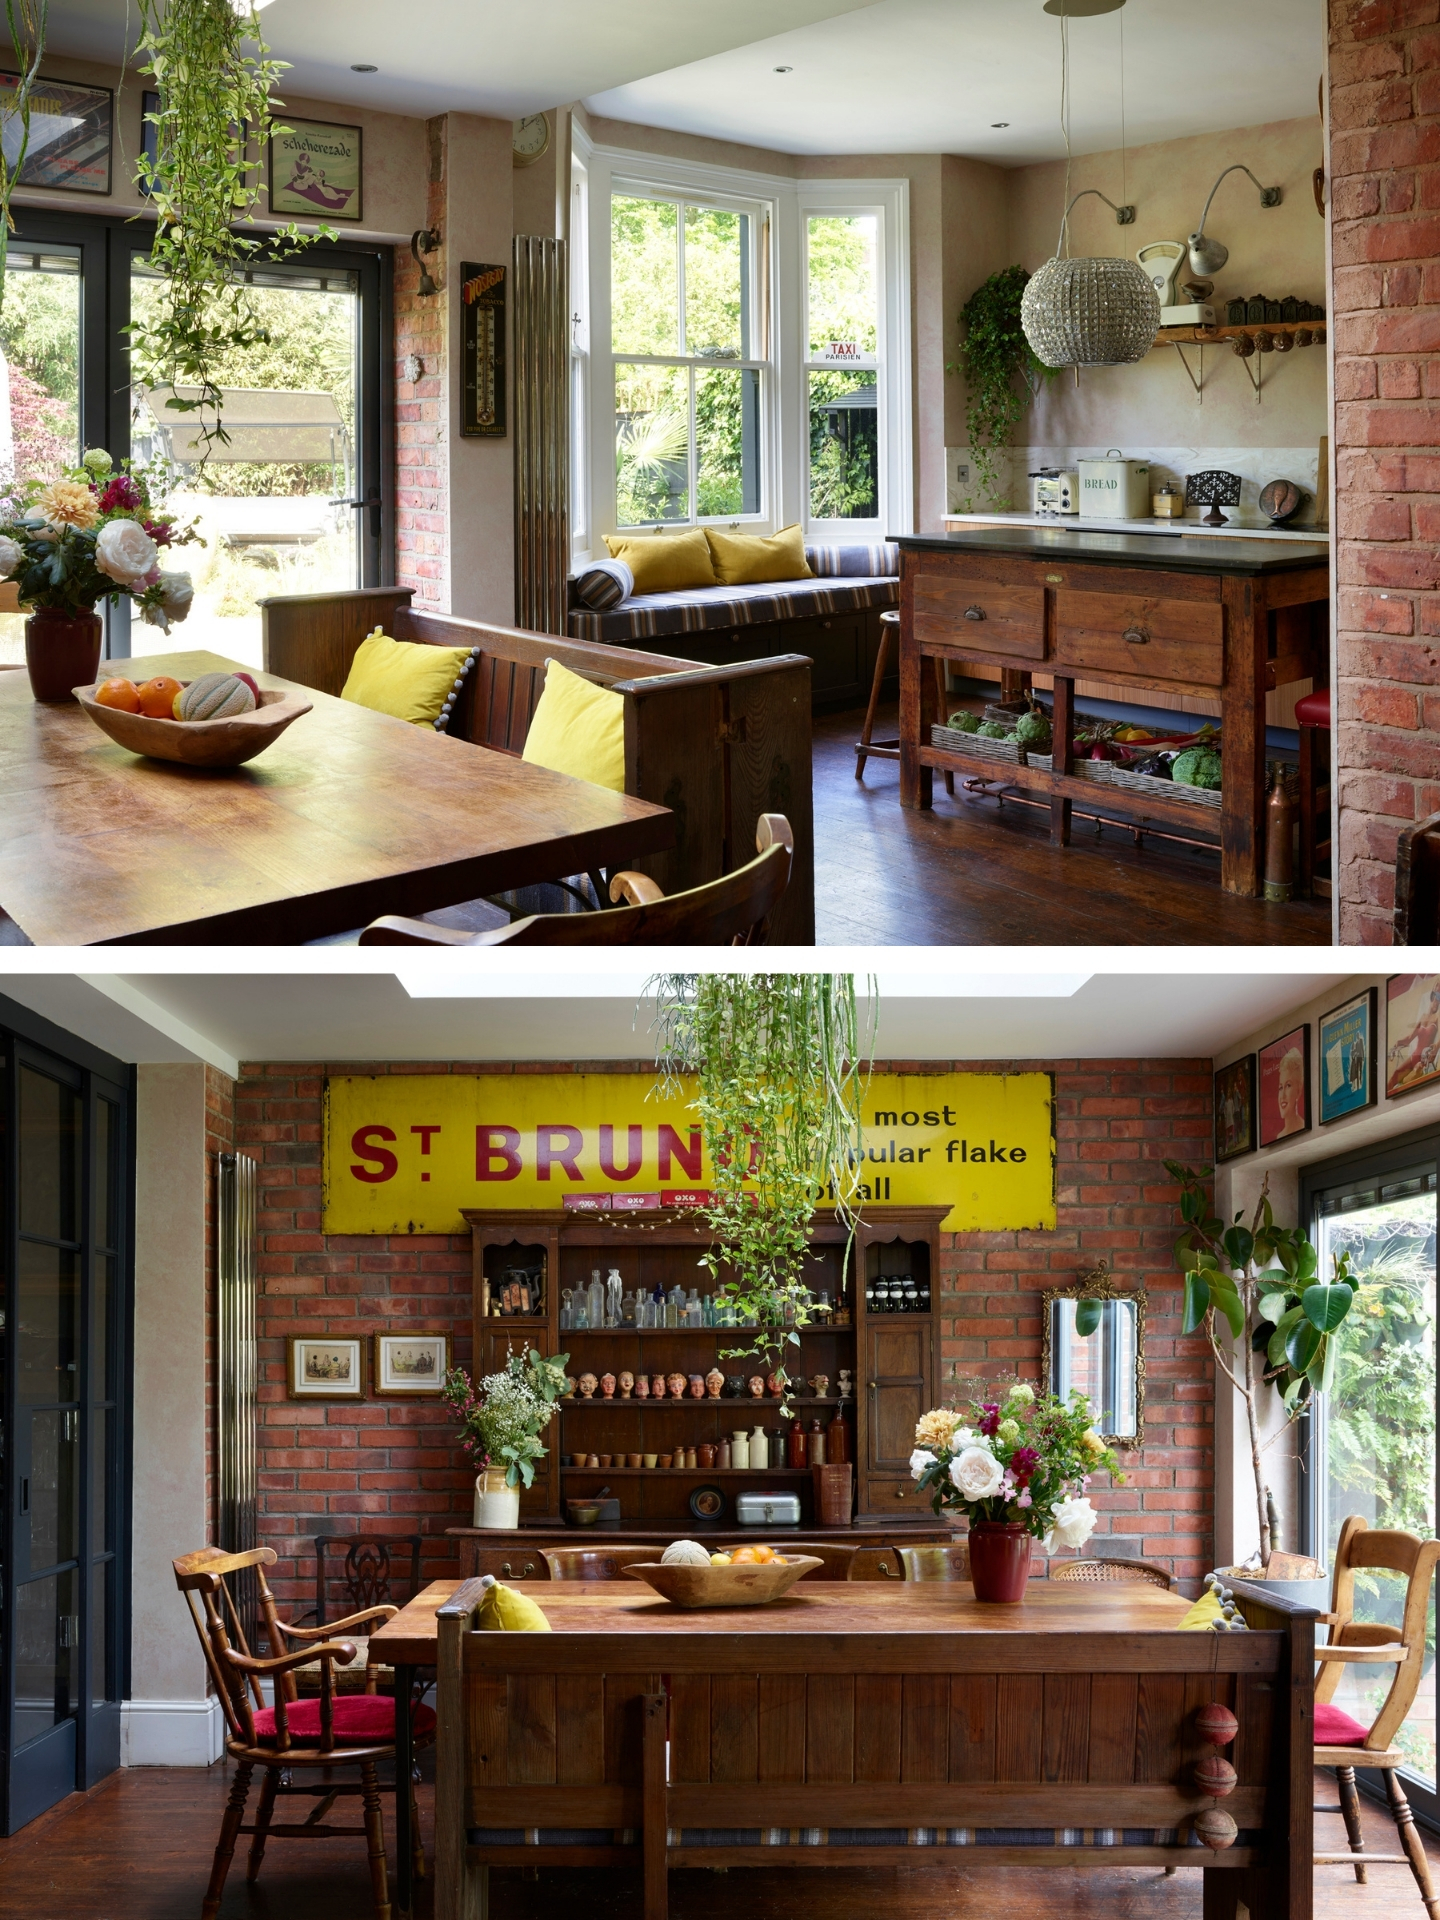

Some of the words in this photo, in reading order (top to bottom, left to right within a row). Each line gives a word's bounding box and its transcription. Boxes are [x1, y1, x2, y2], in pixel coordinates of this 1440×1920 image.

[282, 137, 352, 157] scheherezade
[831, 344, 856, 354] TAXI
[1084, 479, 1118, 489] BREAD
[875, 1105, 957, 1126] most
[945, 1139, 1027, 1163] flake
[855, 1176, 890, 1201] all
